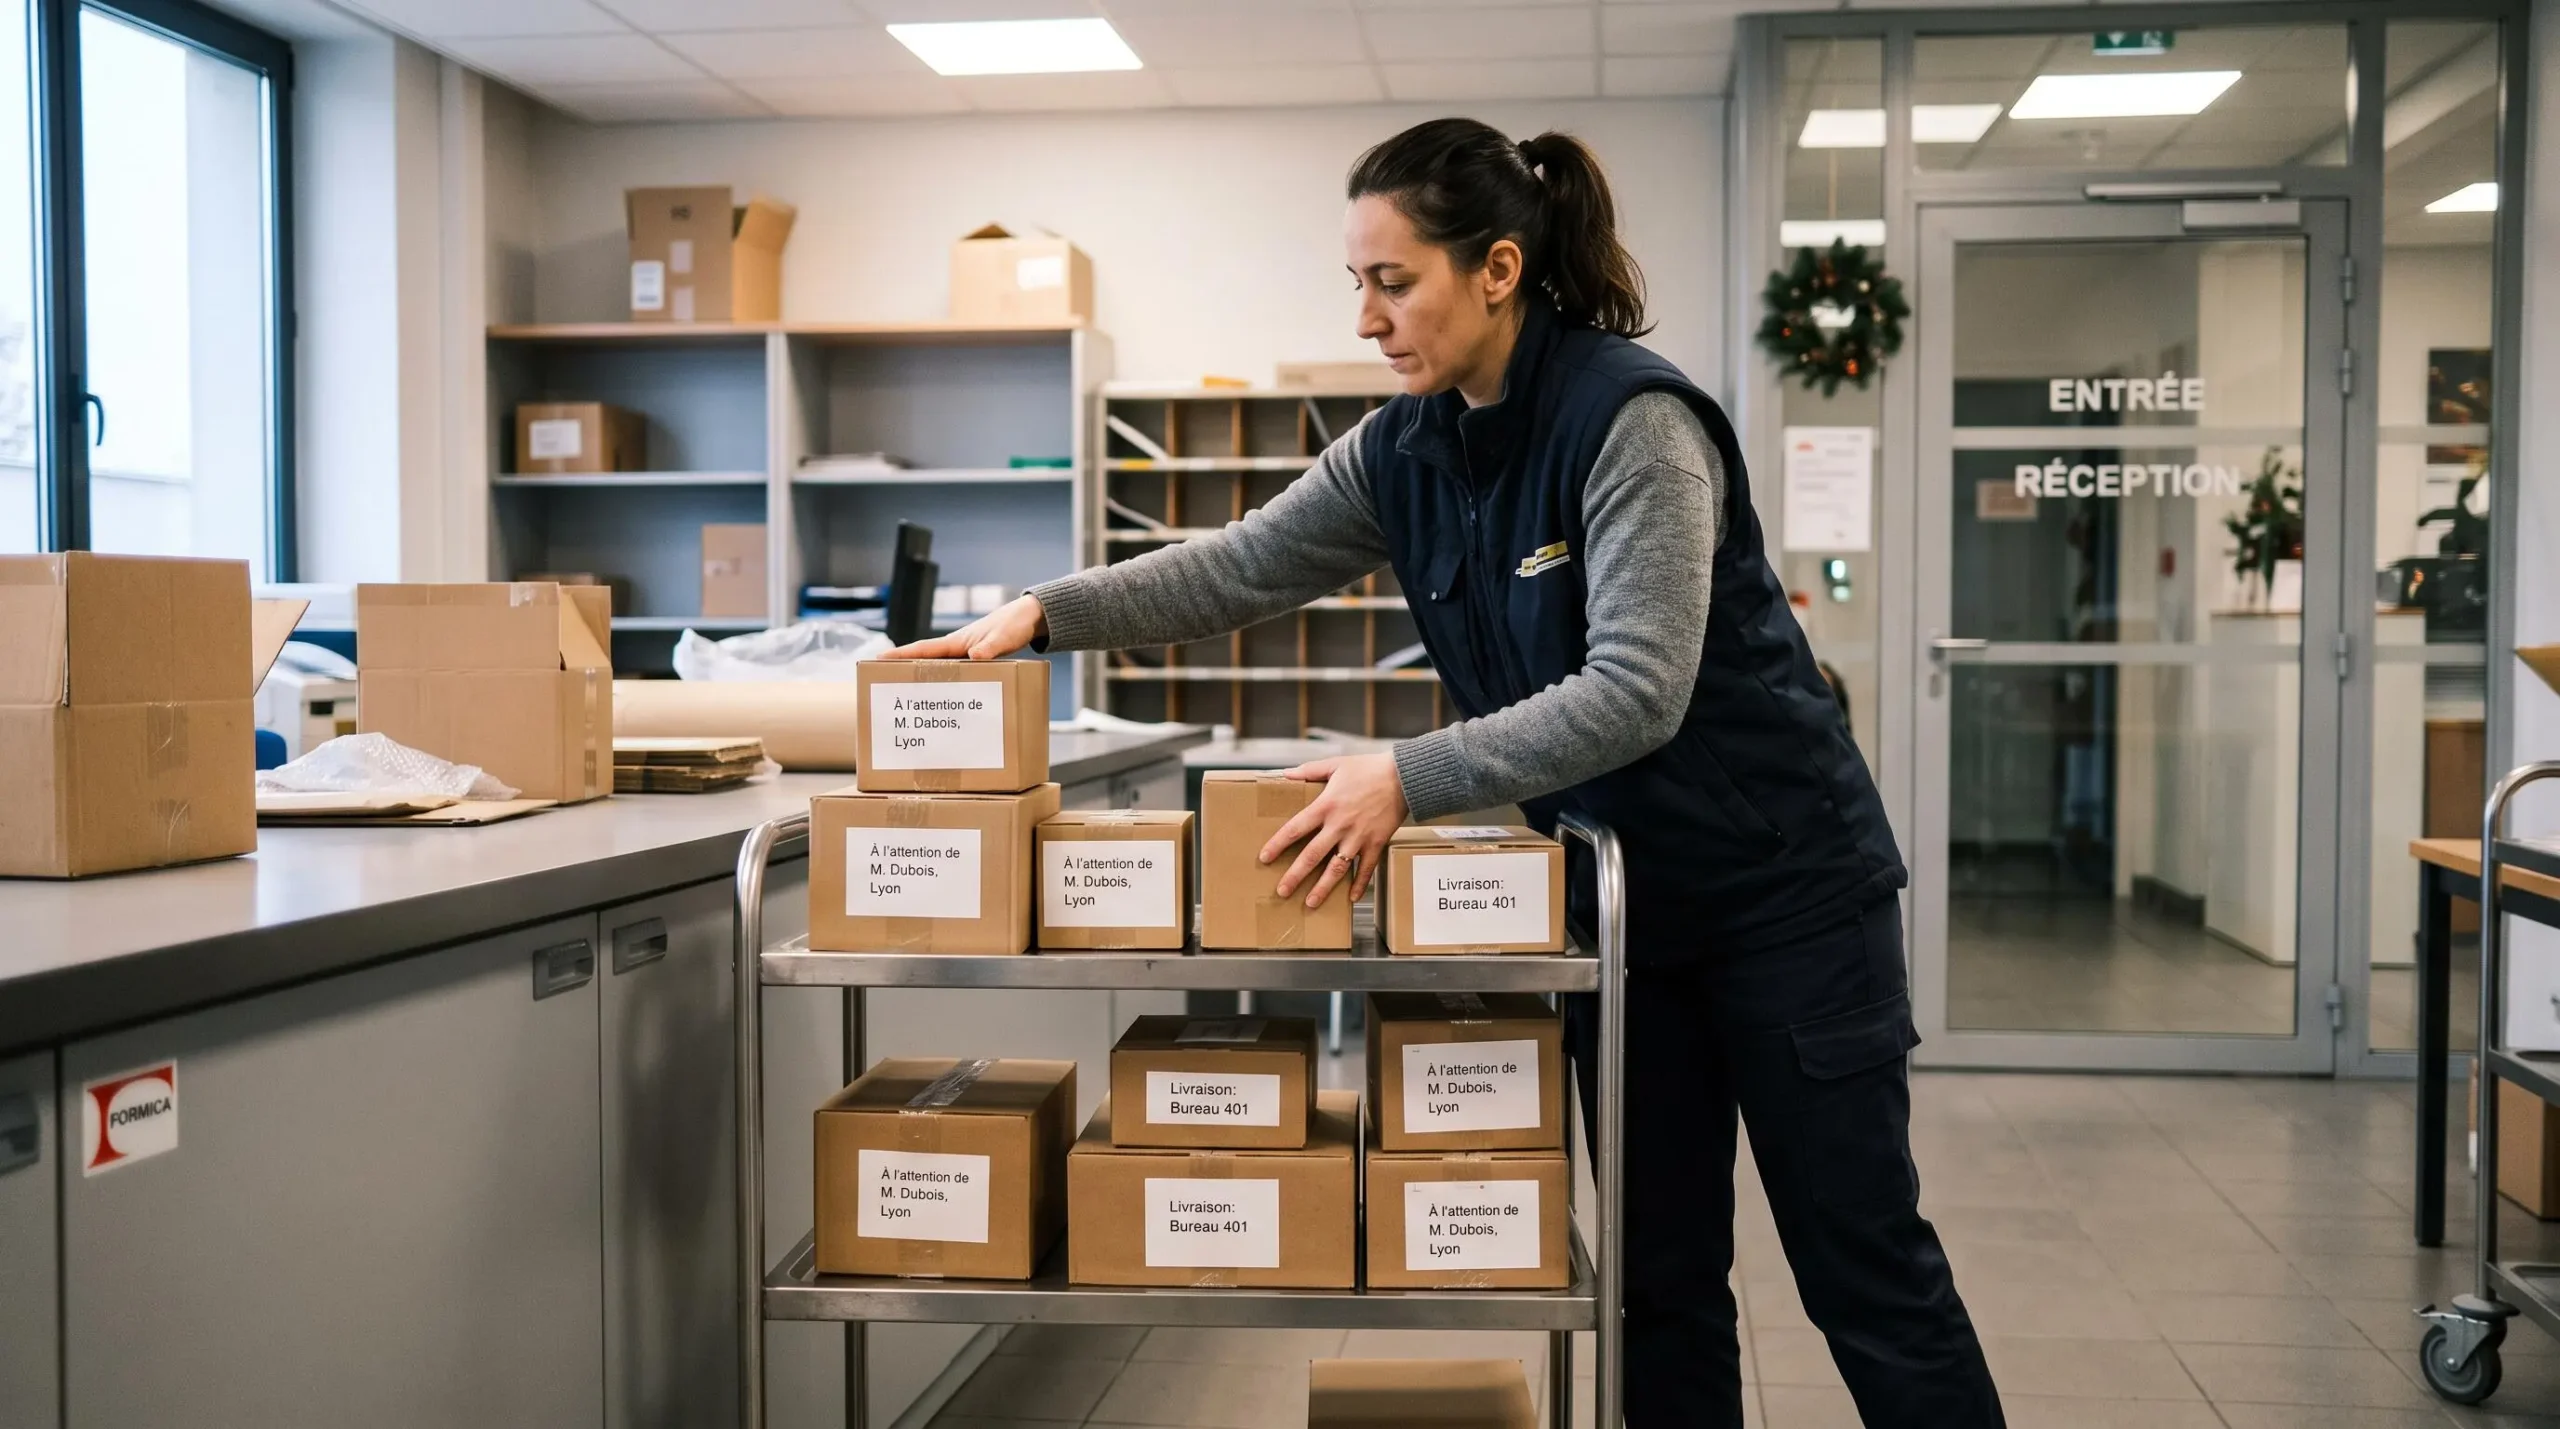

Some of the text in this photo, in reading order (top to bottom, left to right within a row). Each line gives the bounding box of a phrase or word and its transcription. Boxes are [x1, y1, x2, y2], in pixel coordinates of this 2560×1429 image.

[2049, 369, 2206, 412] ENTRÉE
[2014, 456, 2241, 498] RÉCEPTION
[893, 696, 983, 711] À l'attention de
[894, 716, 961, 730] M. Dabois,
[894, 735, 926, 750] Lyon
[870, 842, 961, 859] À l'attention de
[1063, 855, 1153, 870] À l'attention de
[870, 863, 939, 878] M. Dubois,
[870, 881, 902, 897] Lyon
[1064, 875, 1132, 889] M. Dubois,
[1438, 877, 1504, 891] Livraison:
[1064, 893, 1096, 909] Lyon
[1438, 895, 1516, 911] Bureau 401
[1427, 1061, 1518, 1077] À l'attention de
[1170, 1081, 1237, 1096] Livraison:
[1427, 1080, 1497, 1095] M. Dubois,
[110, 1097, 172, 1129] FORMICA
[1170, 1101, 1248, 1116] Bureau 401
[1428, 1101, 1460, 1117] Lyon
[881, 1166, 970, 1183] À l'attention de
[880, 1186, 948, 1203] M. Dubois,
[880, 1204, 911, 1219] Lyon
[1169, 1200, 1236, 1214] Livraison:
[1428, 1202, 1519, 1218] À l'attention de
[1169, 1219, 1248, 1233] Bureau 401
[1429, 1222, 1498, 1237] M. Dubois,
[1429, 1243, 1461, 1258] Lyon
